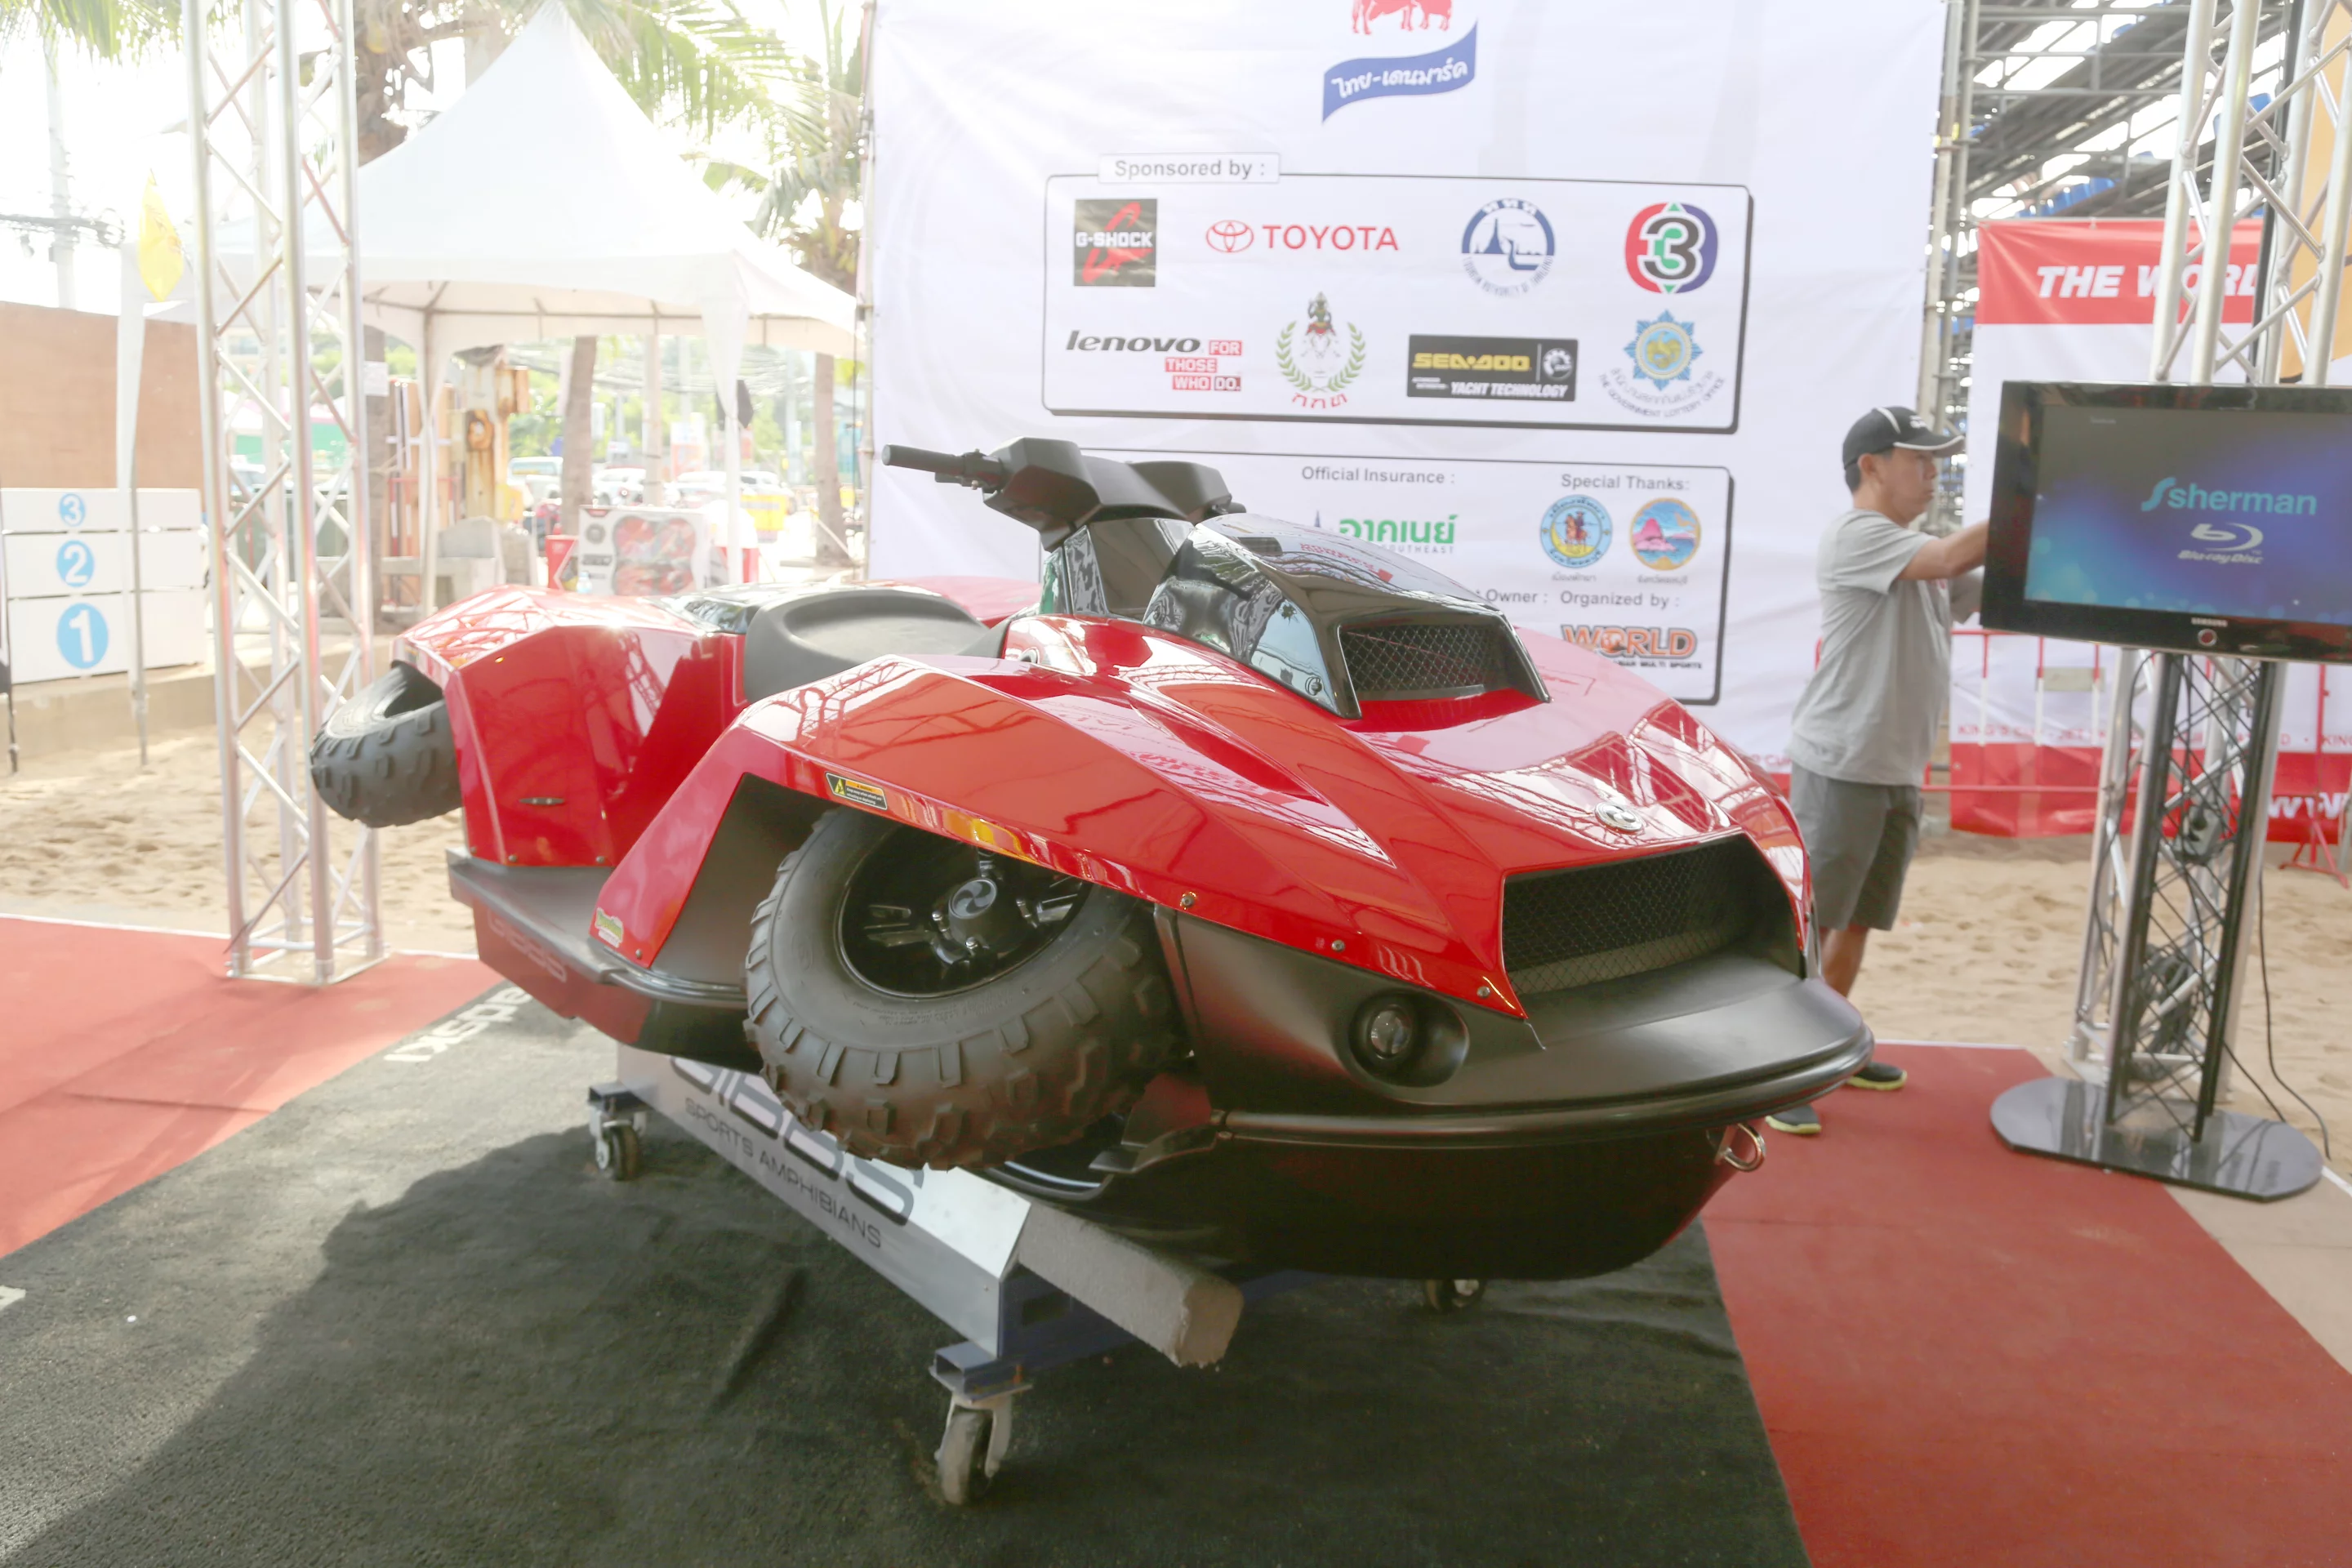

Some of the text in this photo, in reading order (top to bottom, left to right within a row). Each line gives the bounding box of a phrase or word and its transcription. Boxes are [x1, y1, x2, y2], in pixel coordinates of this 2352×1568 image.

[1114, 160, 1222, 179] Sponsored
[1229, 160, 1253, 180] by
[1075, 230, 1154, 248] G-SHOCK
[1263, 225, 1399, 251] TOYOTA
[1643, 216, 1699, 280] 3
[2037, 265, 2125, 298] THE
[1066, 330, 1241, 354] lenovo FOR
[1167, 358, 1216, 372] THOSE
[1174, 376, 1210, 390] WHO
[1450, 381, 1490, 396] YACHT
[1490, 382, 1568, 398] TECHNOLOGY
[1302, 466, 1360, 481] Official
[1365, 467, 1446, 483] Insurance
[1561, 473, 1621, 491] Special
[63, 494, 82, 526] 3
[2167, 483, 2319, 516] sherman
[63, 543, 88, 584] 2
[1486, 589, 1539, 604] Owner
[1561, 590, 1643, 608] Organized
[1650, 590, 1669, 611] by
[68, 608, 95, 663] 1
[1561, 625, 1698, 659] WORLD
[685, 1096, 882, 1249] SPORTS AMPHIBIANS
